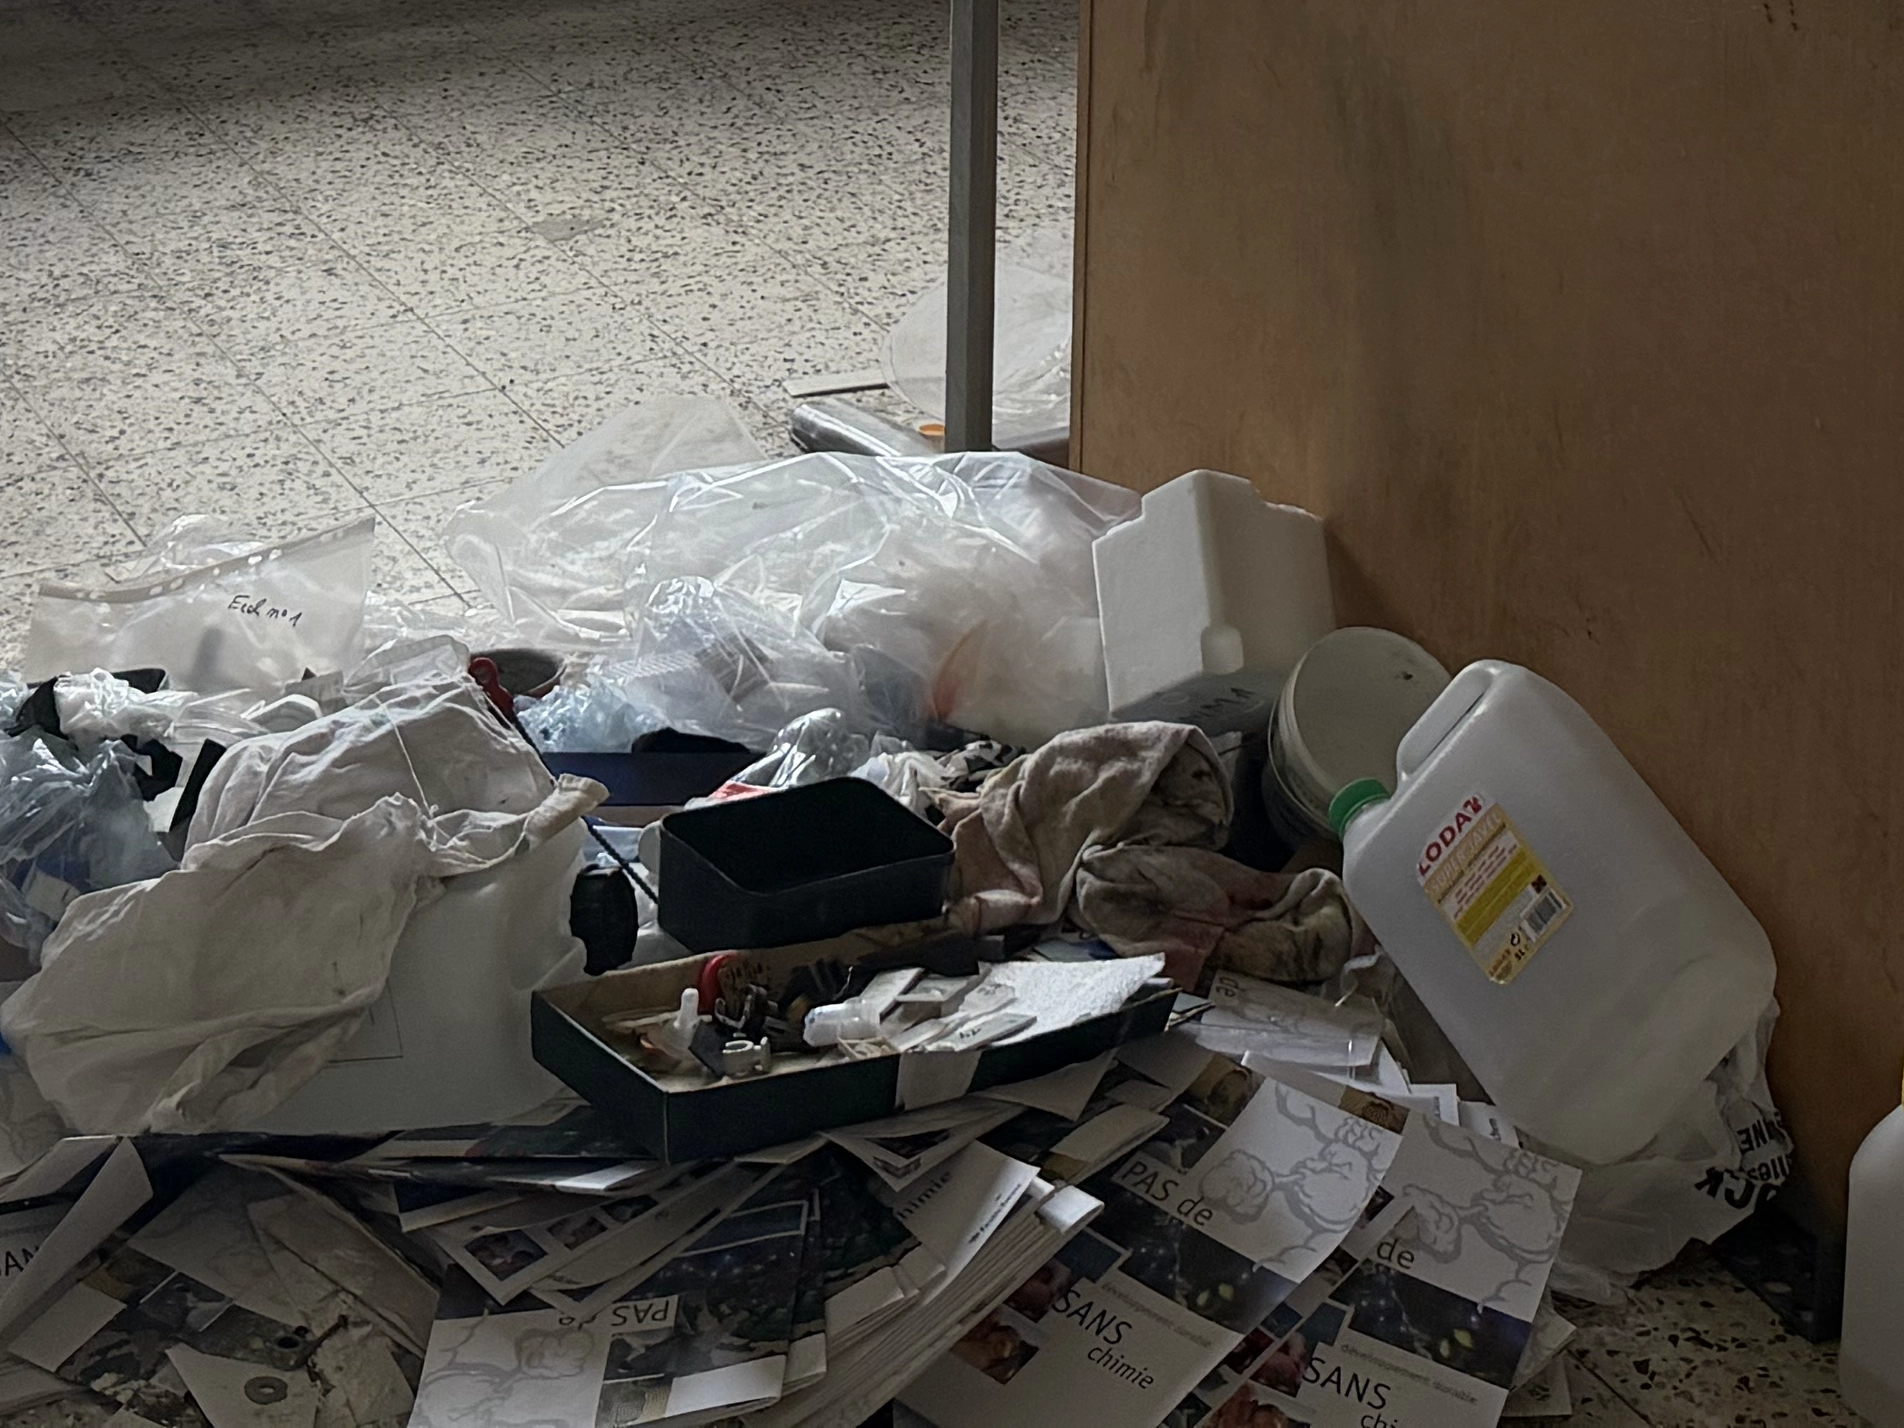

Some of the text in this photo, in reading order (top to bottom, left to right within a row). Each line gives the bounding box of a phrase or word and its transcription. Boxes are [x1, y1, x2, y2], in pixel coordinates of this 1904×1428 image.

[1121, 1158, 1214, 1229] PAS de
[1376, 1236, 1416, 1271] de
[610, 1299, 669, 1326] PAS
[1051, 1287, 1133, 1346] SANS
[1087, 1339, 1155, 1391] chimie
[1302, 1357, 1391, 1410] SANS
